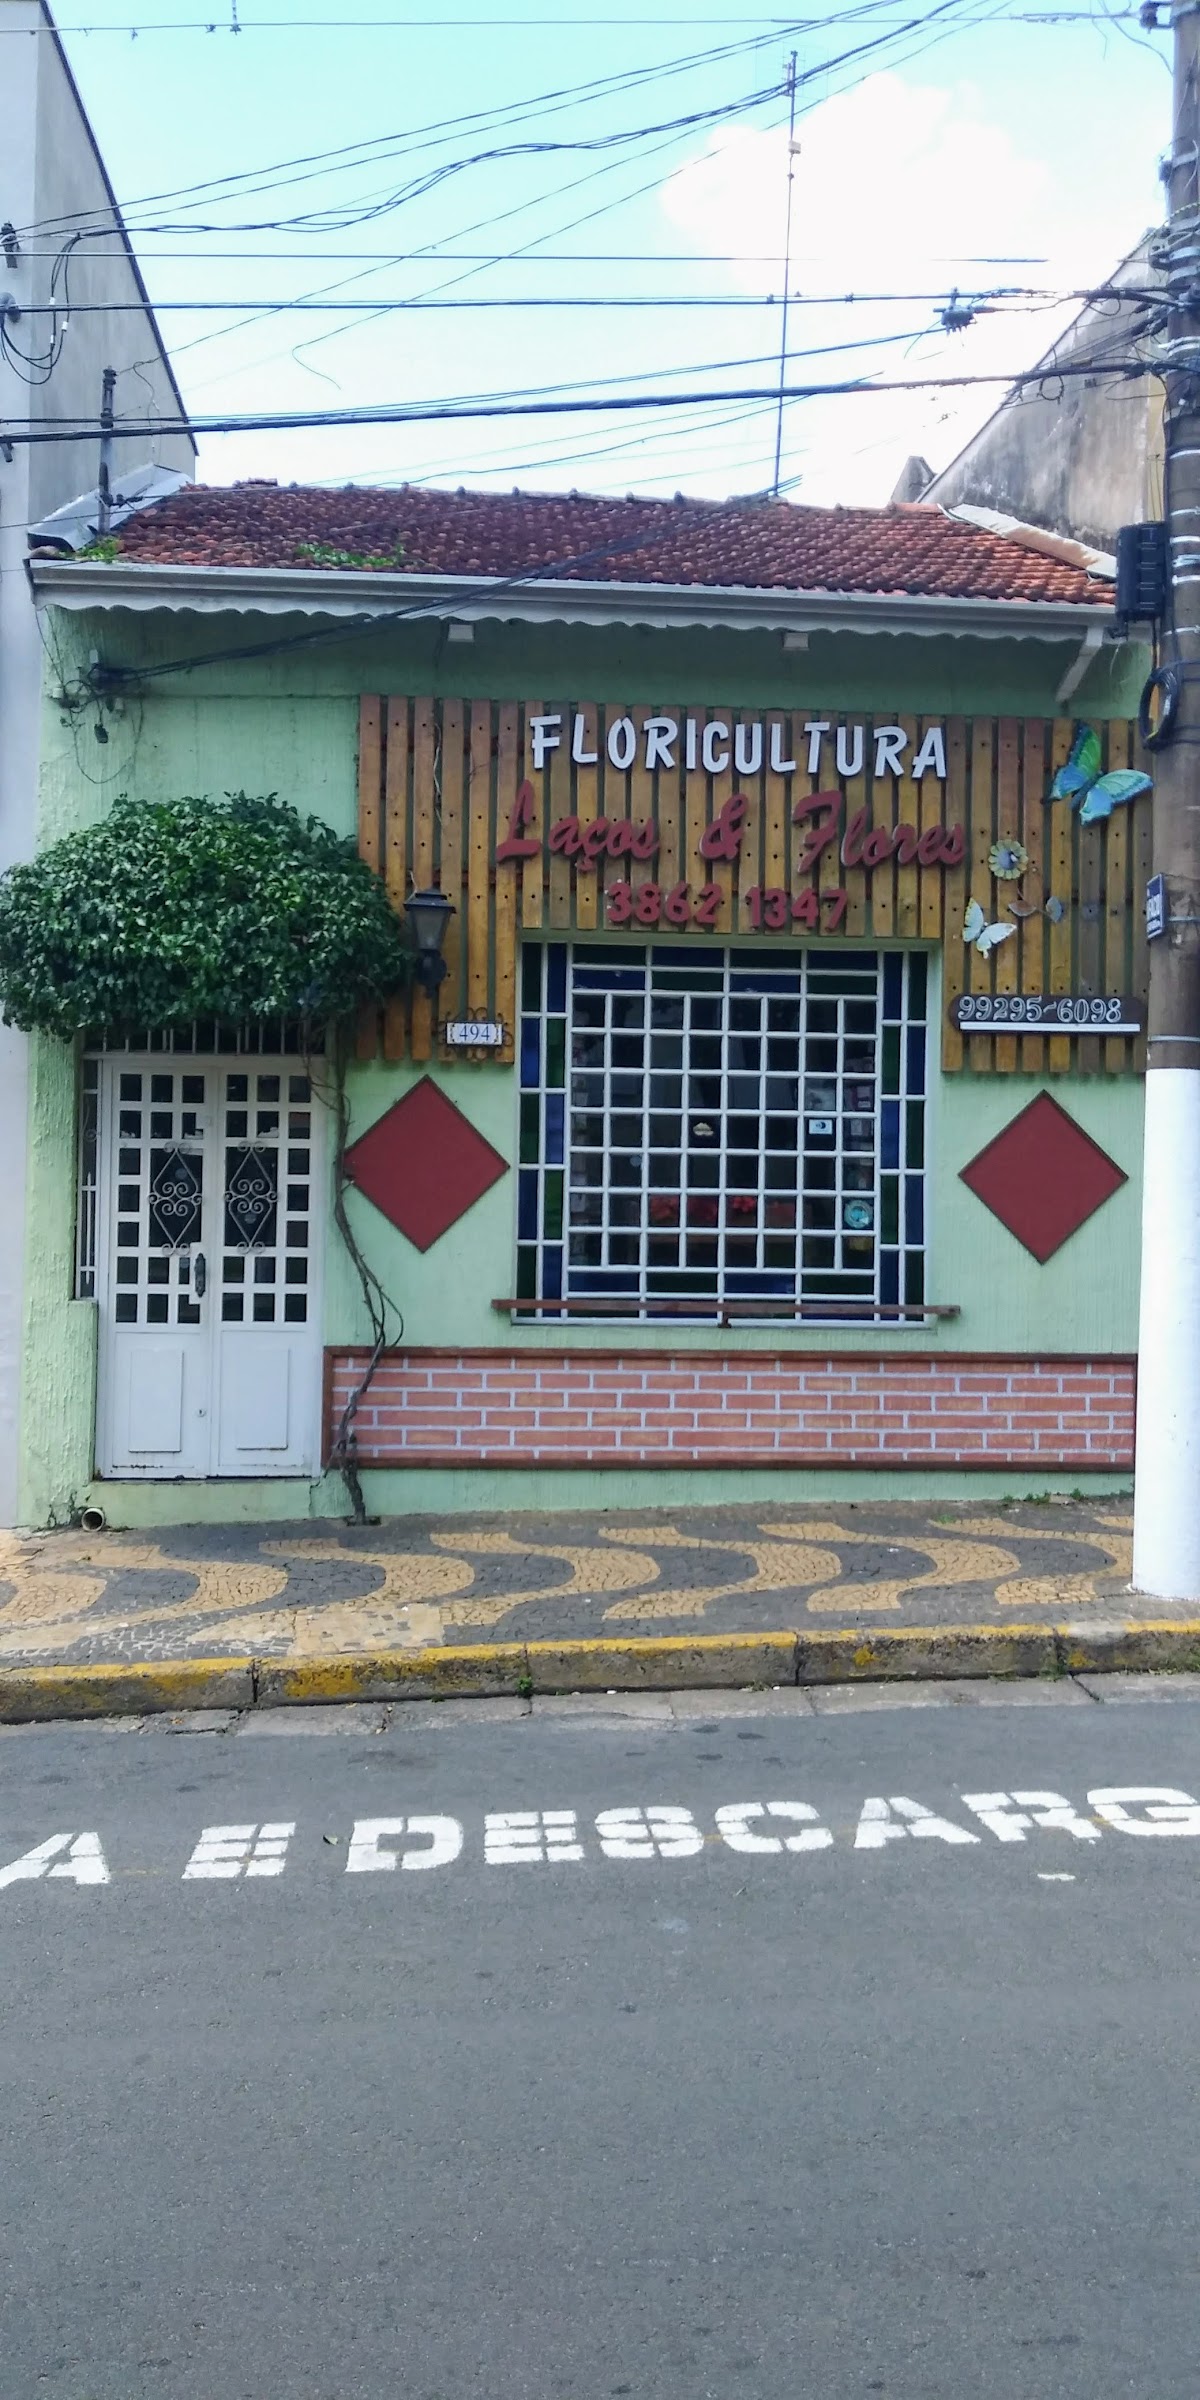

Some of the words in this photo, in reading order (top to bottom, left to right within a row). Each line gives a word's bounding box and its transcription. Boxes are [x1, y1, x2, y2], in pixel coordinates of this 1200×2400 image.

[529, 713, 948, 780] FLORICULTURA
[496, 779, 661, 872] Laços
[698, 792, 750, 861] &
[791, 788, 966, 874] Flores
[605, 880, 723, 925] 3862
[744, 885, 849, 932] 1347
[459, 1024, 491, 1041] 494
[181, 1821, 296, 1880] E
[344, 1786, 1200, 1873] DESCARG
